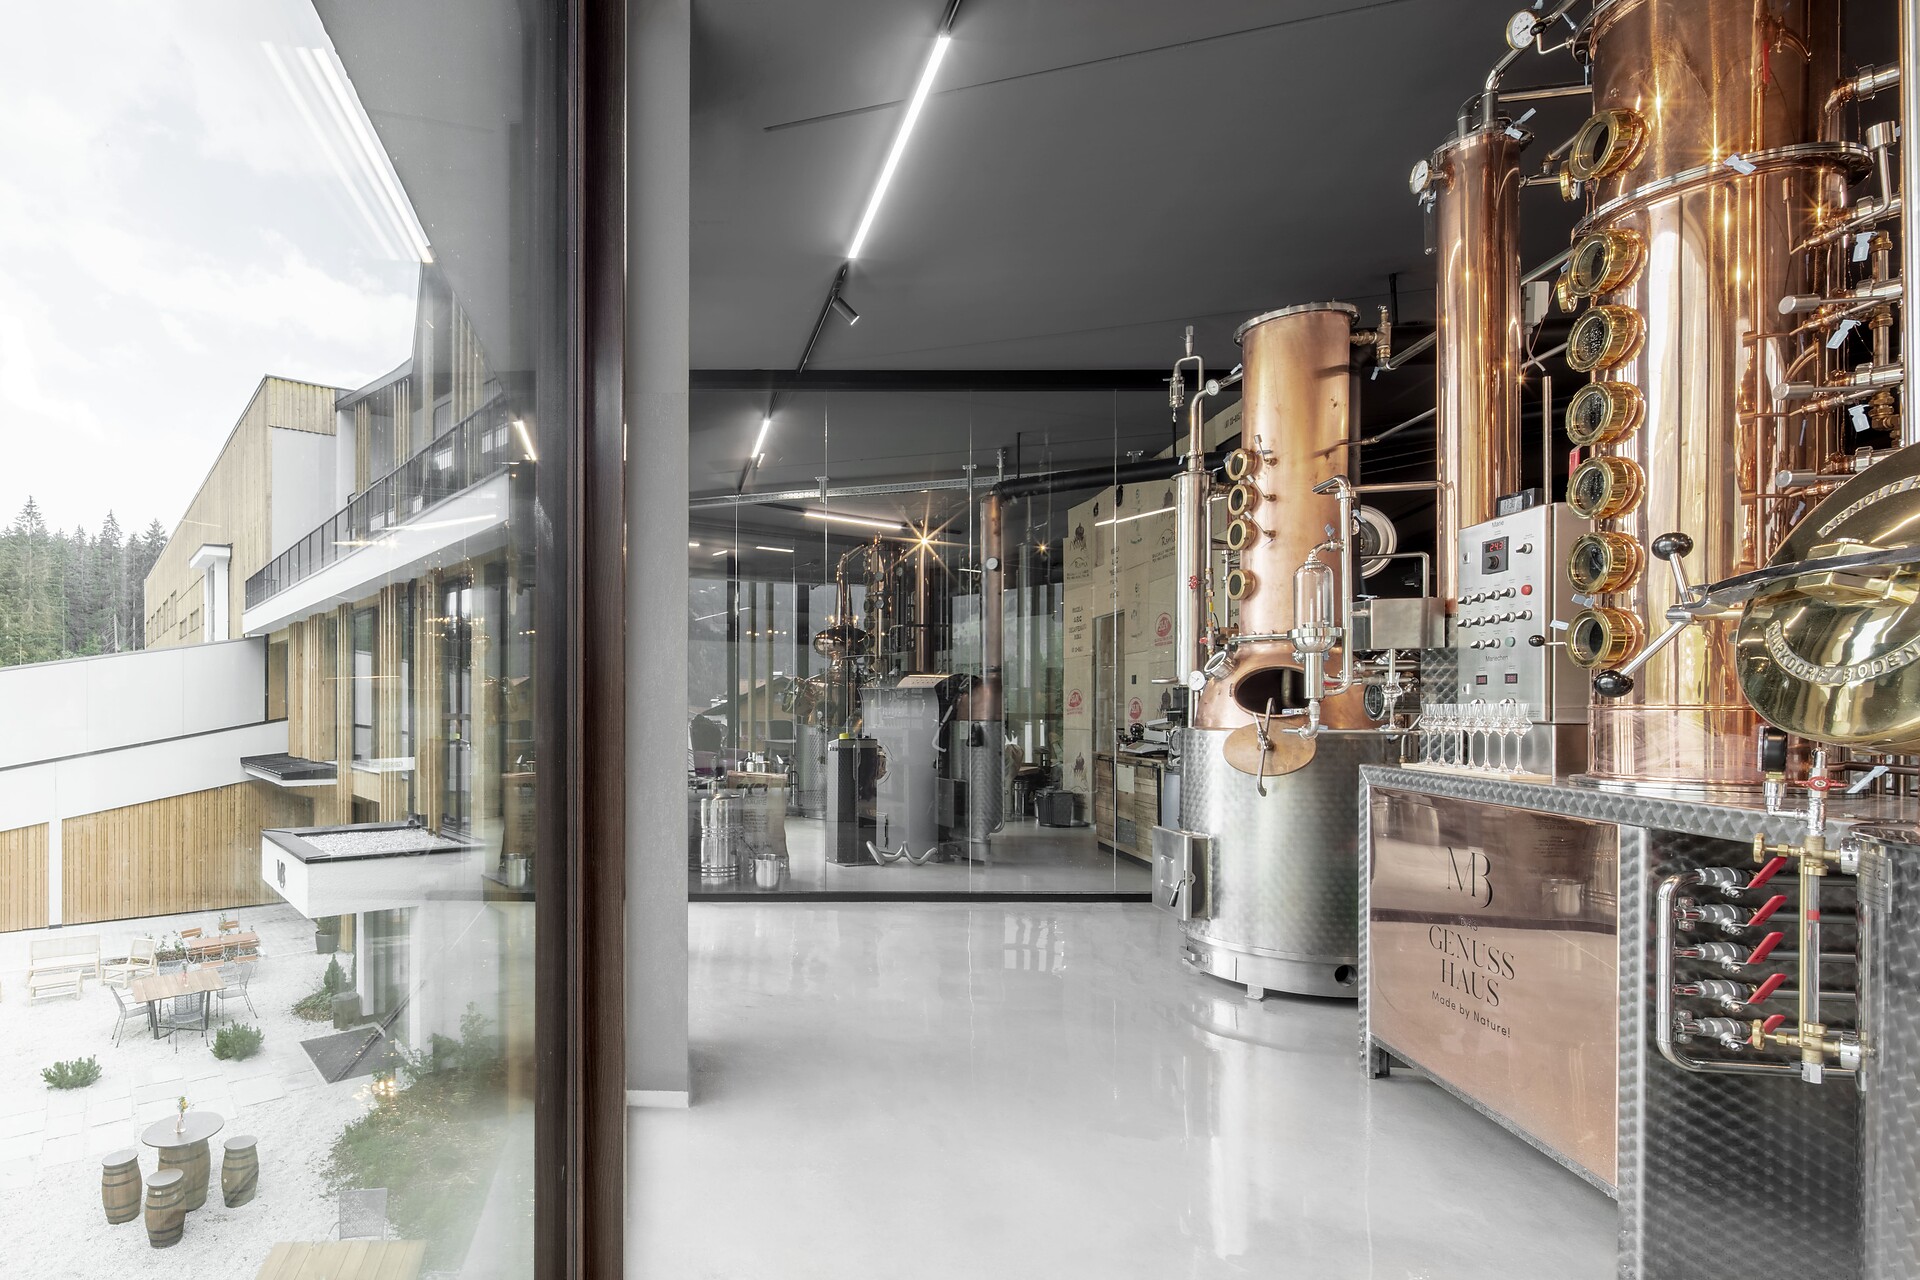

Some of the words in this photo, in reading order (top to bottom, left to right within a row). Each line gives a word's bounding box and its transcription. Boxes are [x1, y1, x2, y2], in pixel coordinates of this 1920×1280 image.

[1824, 482, 1902, 535] ARNOLD
[1446, 846, 1494, 909] MB
[1428, 924, 1515, 981] GENUSS
[1441, 958, 1499, 1008] HAUS
[1431, 990, 1456, 1011] Made
[1459, 1003, 1470, 1020] by
[1473, 1011, 1511, 1038] Nature!
